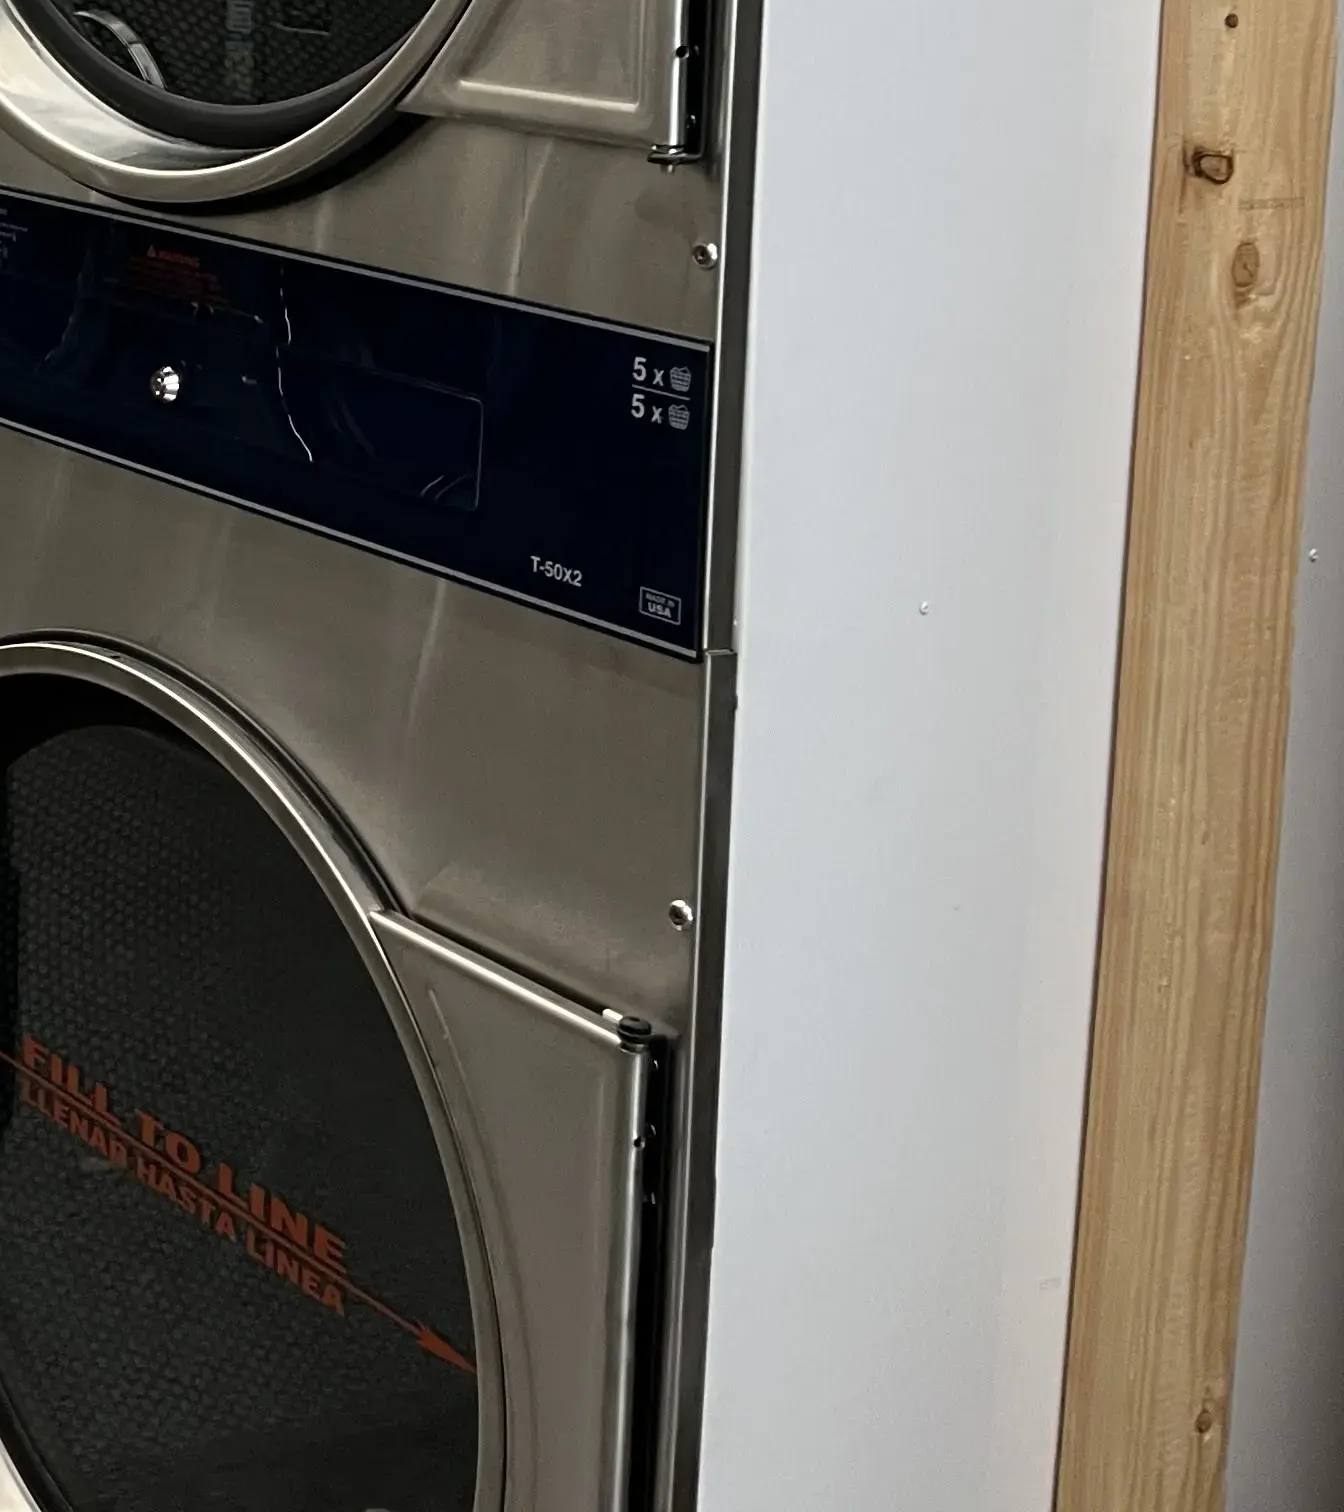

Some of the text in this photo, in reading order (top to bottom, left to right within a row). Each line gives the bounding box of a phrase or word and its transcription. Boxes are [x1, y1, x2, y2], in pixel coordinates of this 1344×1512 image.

[632, 356, 664, 387] 5 x
[631, 393, 663, 424] 5 x
[530, 555, 583, 587] T-50X2
[647, 601, 672, 618] USA
[21, 1034, 349, 1276] FILL TO LINE
[20, 1079, 346, 1317] LLENAR HASTA LINEA
